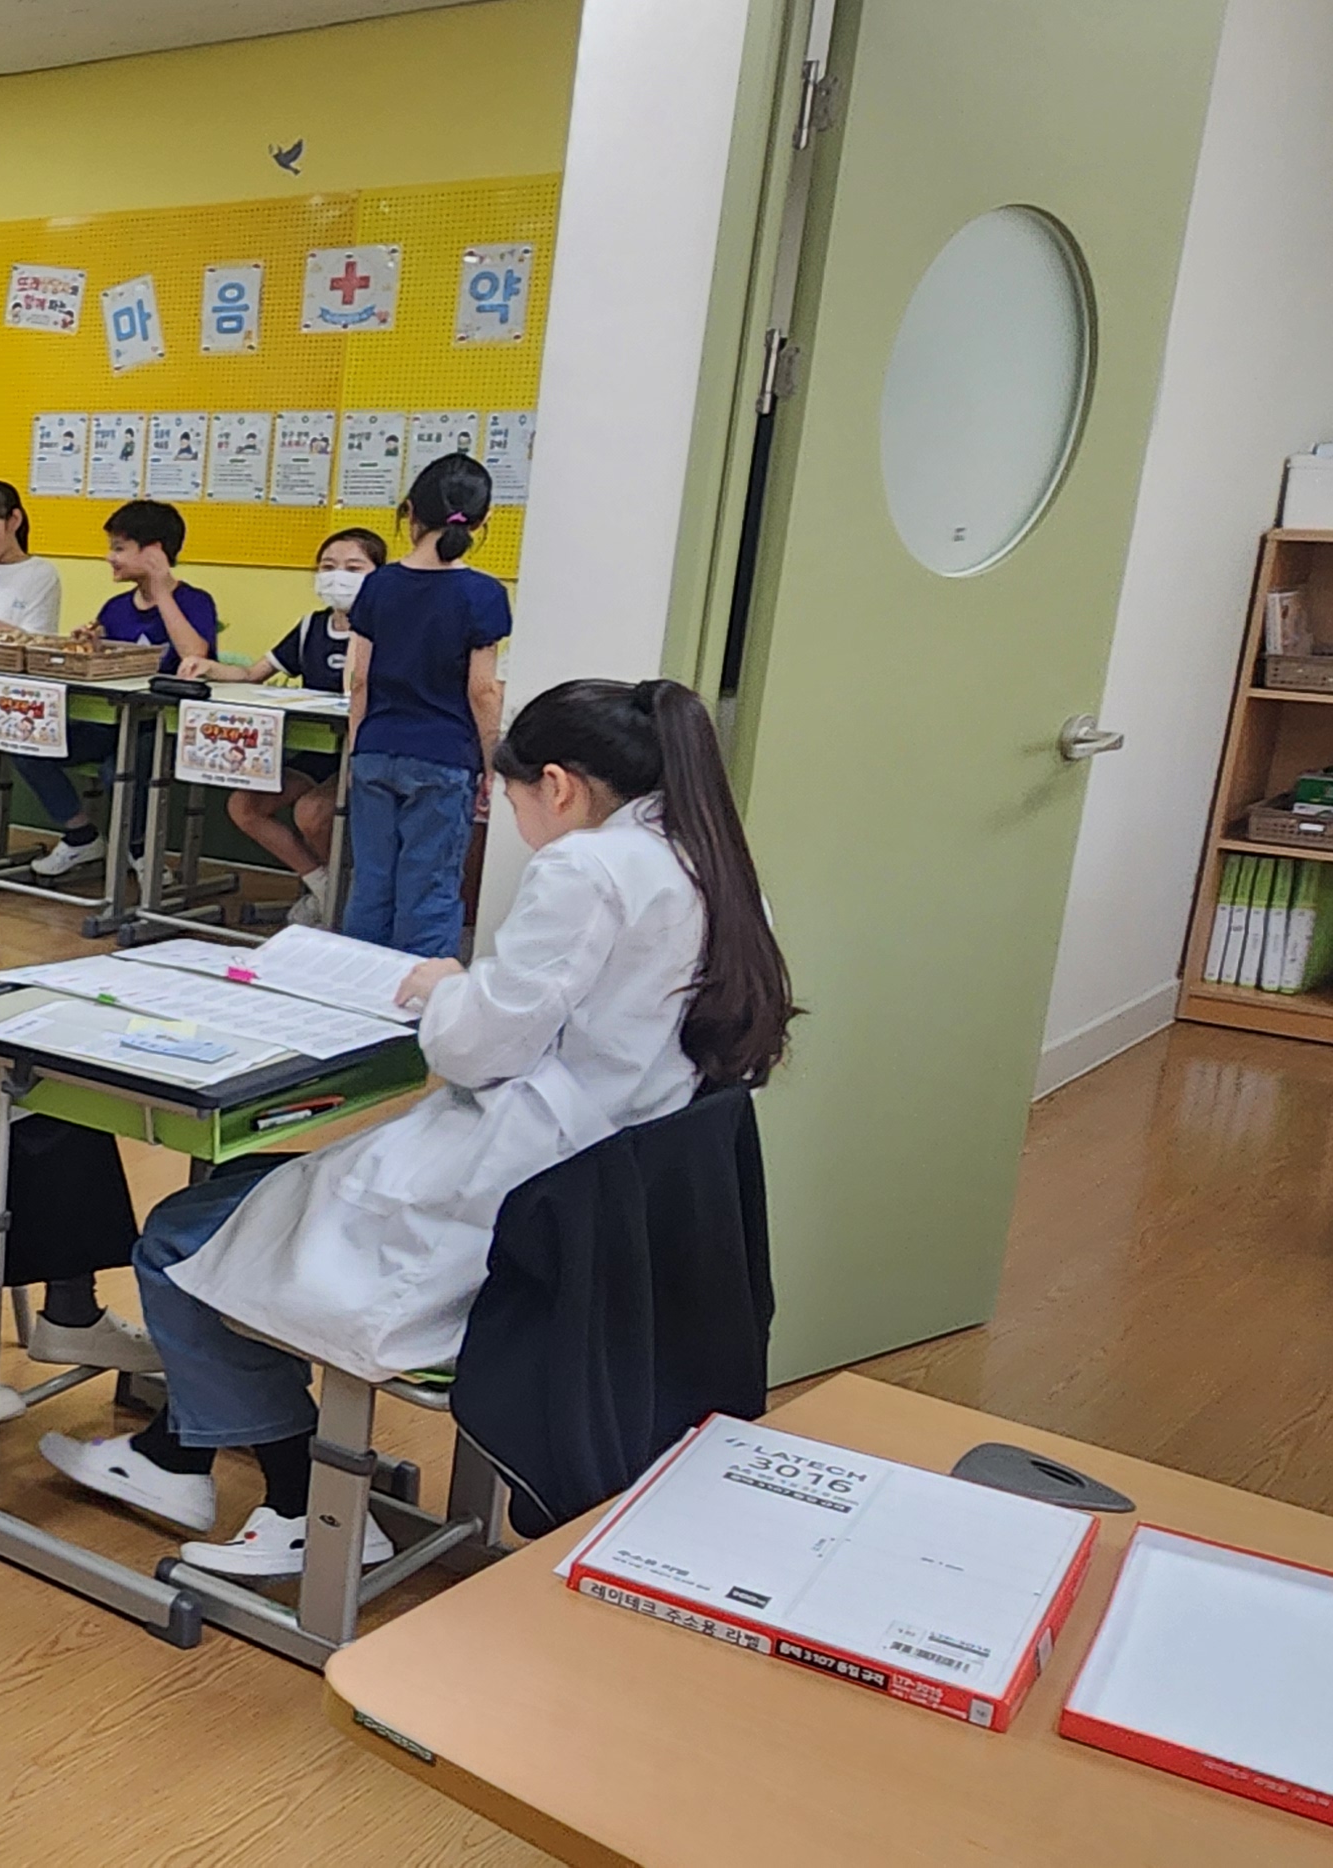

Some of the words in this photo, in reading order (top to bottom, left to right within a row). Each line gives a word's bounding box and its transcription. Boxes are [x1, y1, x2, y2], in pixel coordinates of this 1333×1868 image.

[113, 299, 151, 342] 마
[212, 281, 250, 335] 음
[469, 269, 523, 325] 약
[748, 1456, 854, 1494] 3016
[753, 1445, 868, 1482] LATECH
[591, 1582, 658, 1615] 레이테크
[666, 1607, 718, 1637] 주소용
[725, 1627, 761, 1649] 라벨
[803, 1650, 836, 1667] 3107
